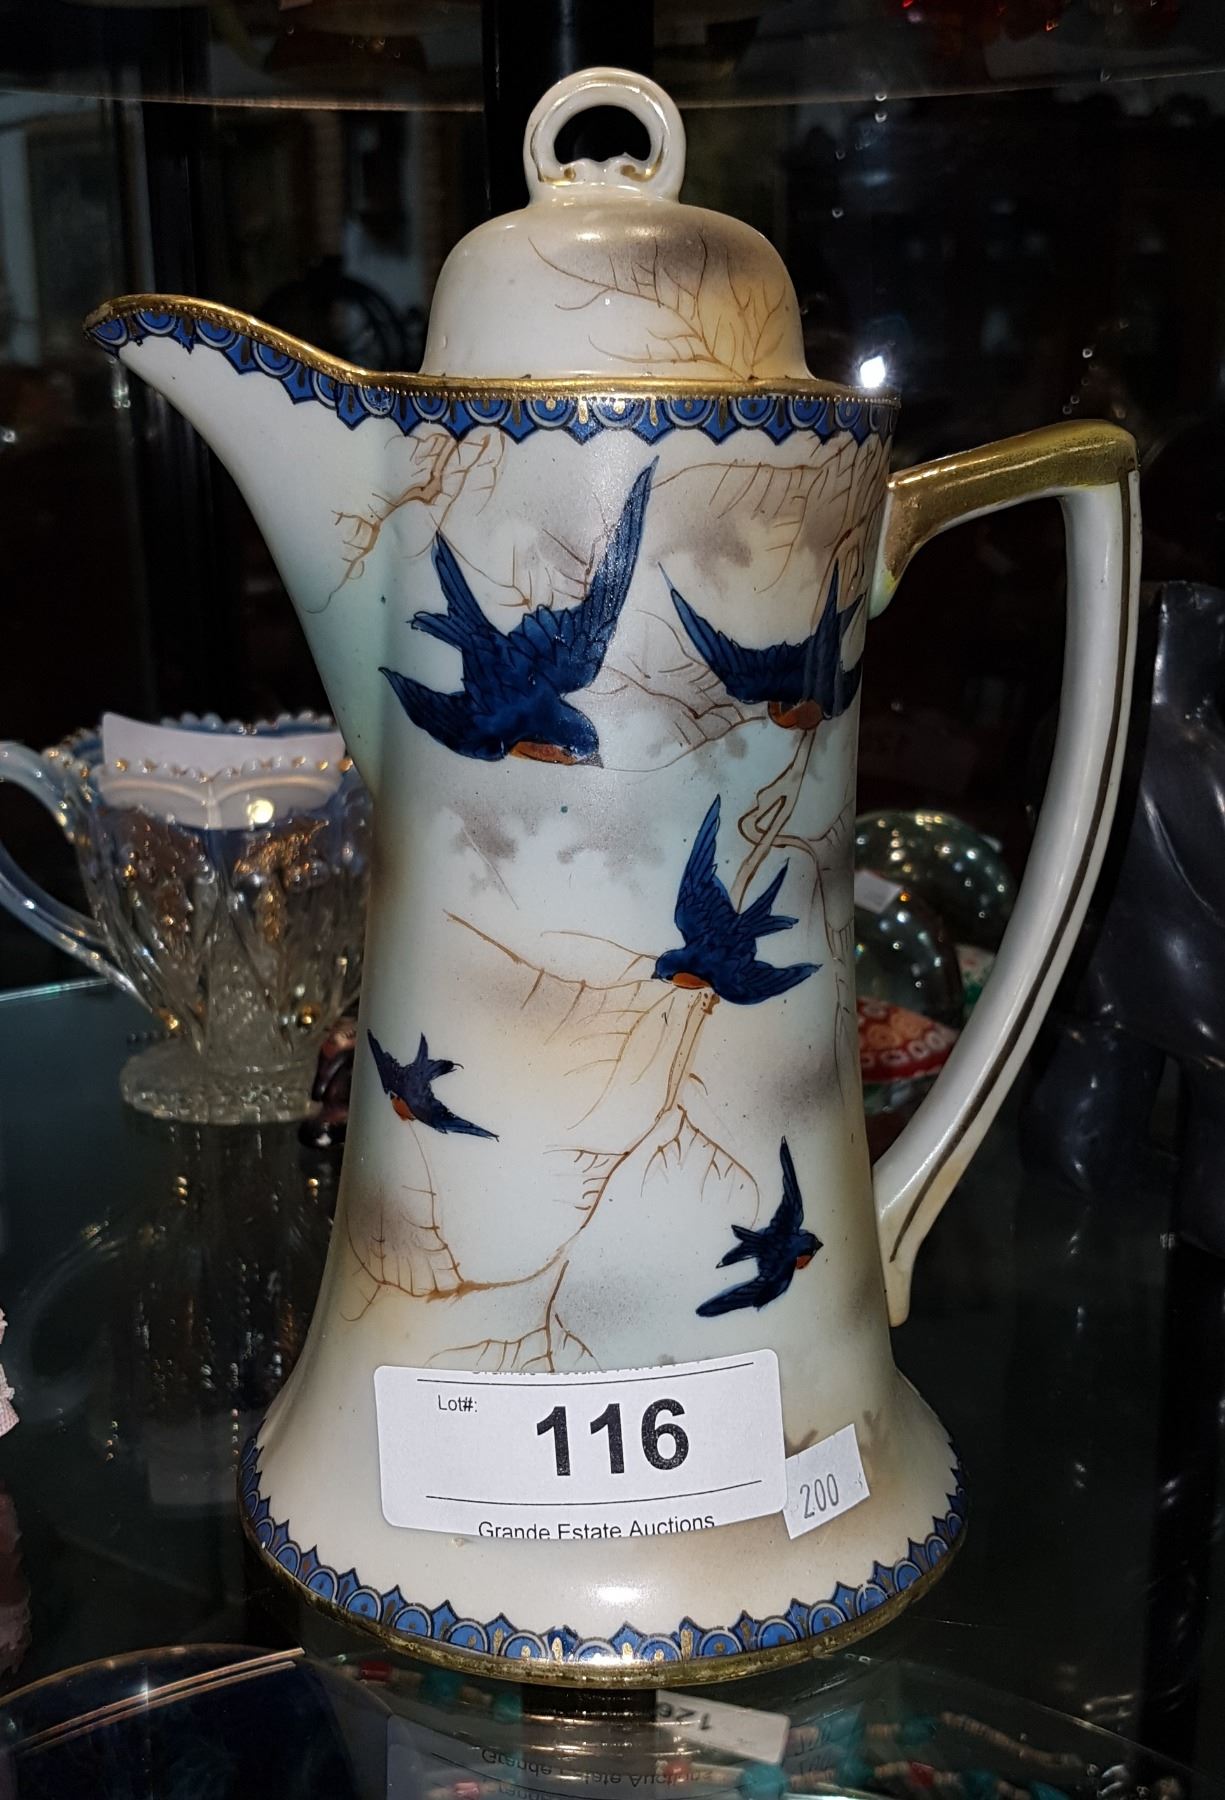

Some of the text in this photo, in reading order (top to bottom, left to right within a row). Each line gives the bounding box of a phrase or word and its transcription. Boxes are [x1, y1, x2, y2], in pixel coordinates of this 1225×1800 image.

[438, 1395, 478, 1412] Lot#:
[536, 1398, 690, 1476] 116
[800, 1474, 839, 1518] 200
[478, 1515, 716, 1540] Grande Estate Auctions
